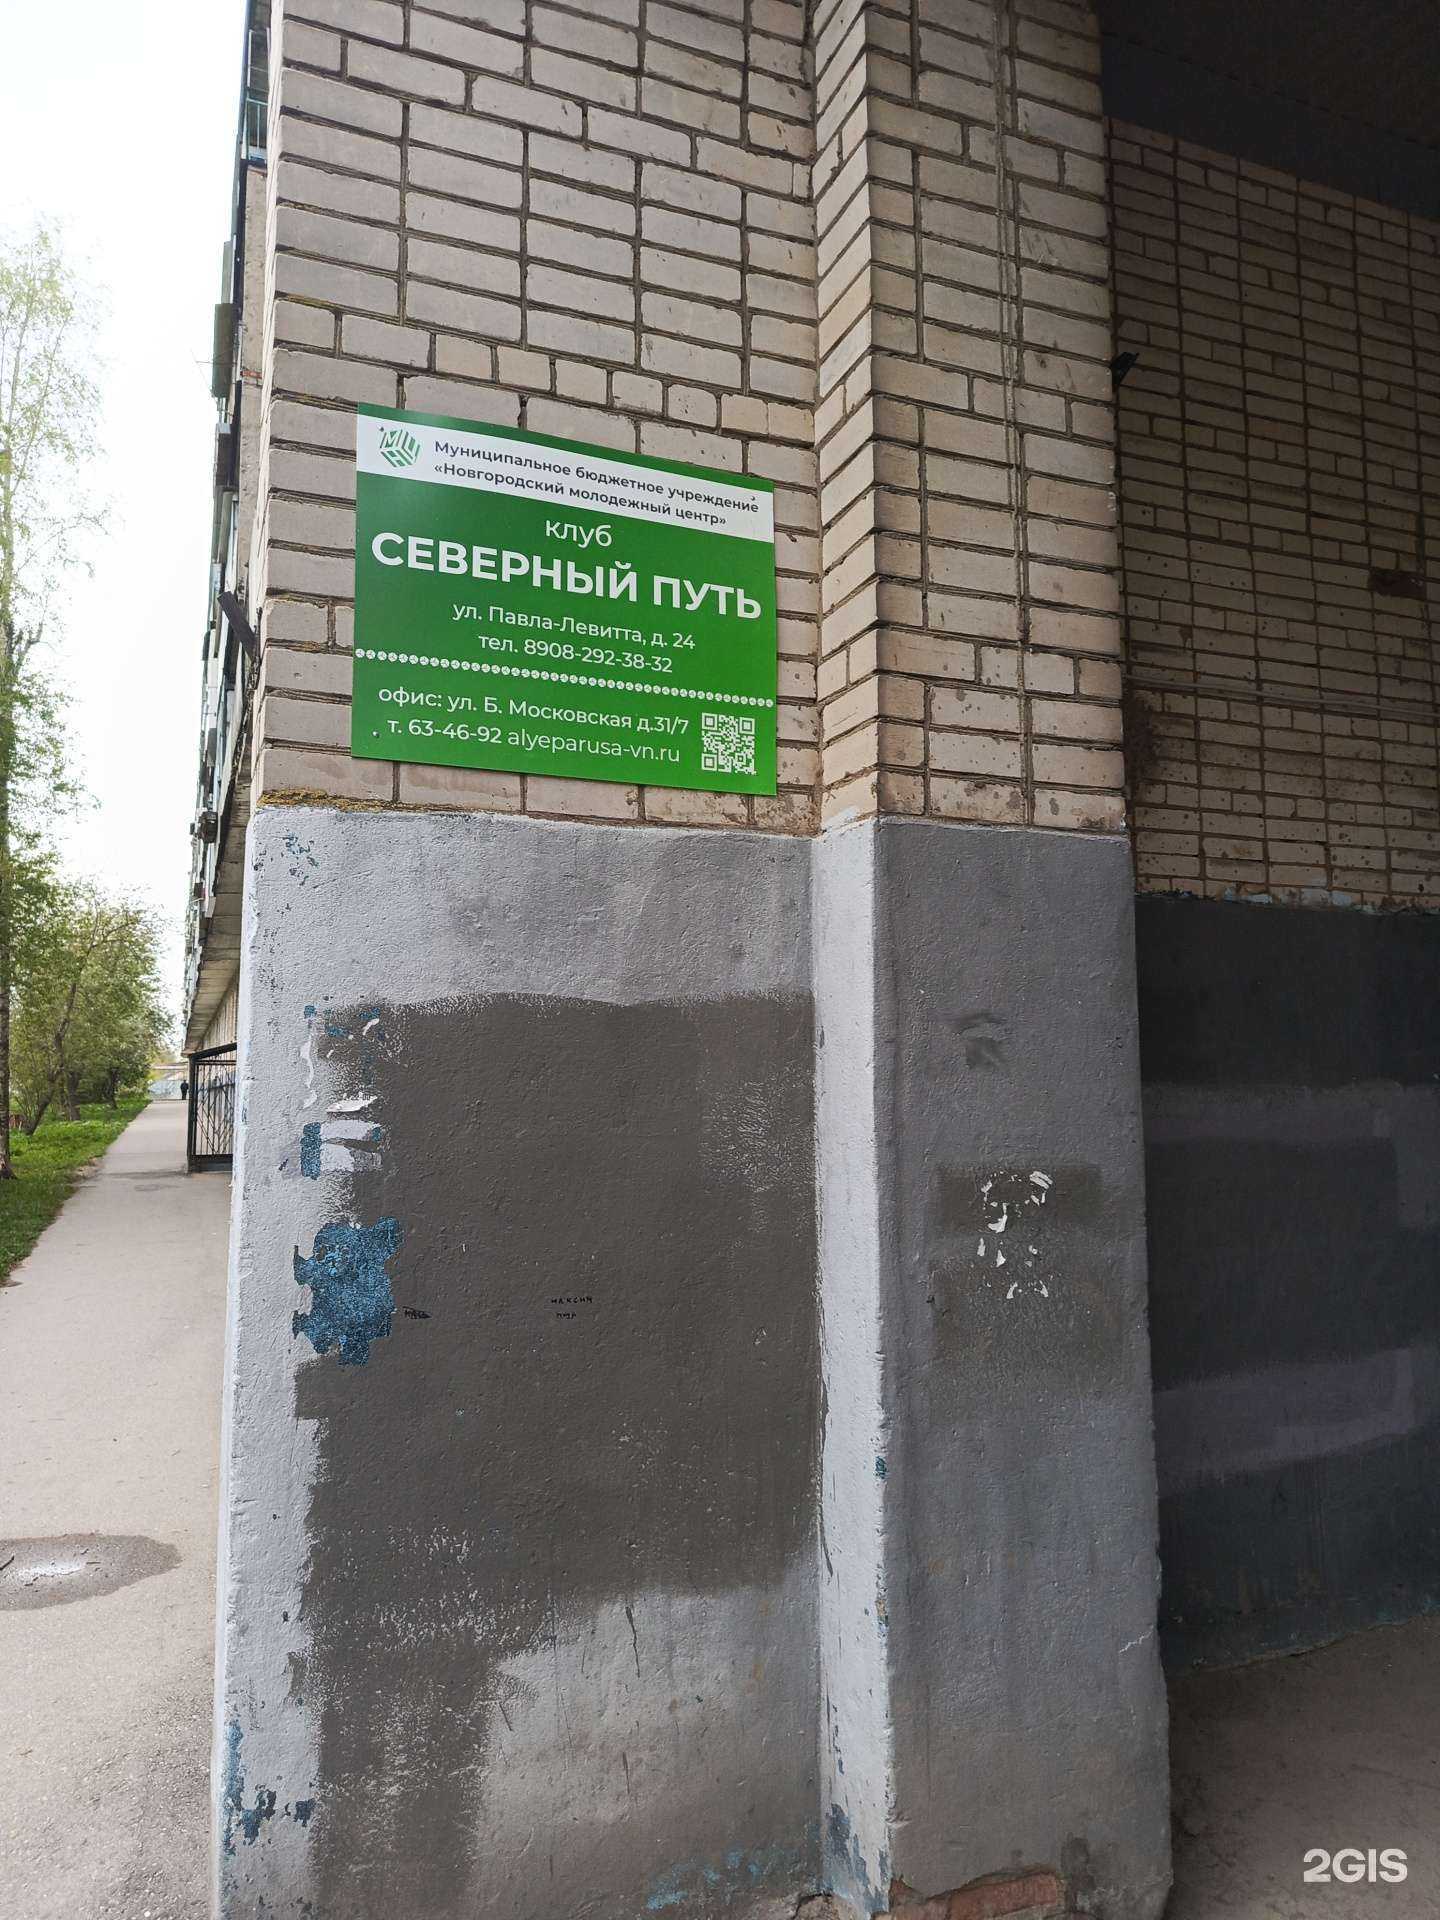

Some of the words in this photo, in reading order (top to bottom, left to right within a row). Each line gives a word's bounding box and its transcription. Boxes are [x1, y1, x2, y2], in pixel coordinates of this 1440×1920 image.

[434, 441, 571, 476] Муниципальное
[575, 467, 664, 494] бюджетное
[668, 487, 760, 512] учреждение
[434, 463, 565, 495] «Новгородский
[569, 486, 671, 515] молодежный
[675, 508, 726, 525] центр»
[545, 520, 613, 549] клуб
[371, 532, 638, 602] СЕВЕРНЫЙ
[653, 575, 762, 619] ПУТЬ
[452, 604, 483, 621] ул.
[489, 606, 647, 646] Павла-Левитта,
[651, 633, 668, 647] д.
[672, 633, 696, 650] 24
[478, 635, 519, 653] тел.
[524, 639, 673, 674] 8908-292-38-32
[378, 686, 442, 708] офис:
[447, 695, 477, 713] ул.
[484, 697, 502, 714] Б.
[509, 700, 632, 729] Московская
[637, 717, 689, 735] д.31/7
[387, 719, 403, 734] т.
[408, 719, 502, 744] 63-46-92
[507, 728, 680, 762] alyeparusa-vn.ru
